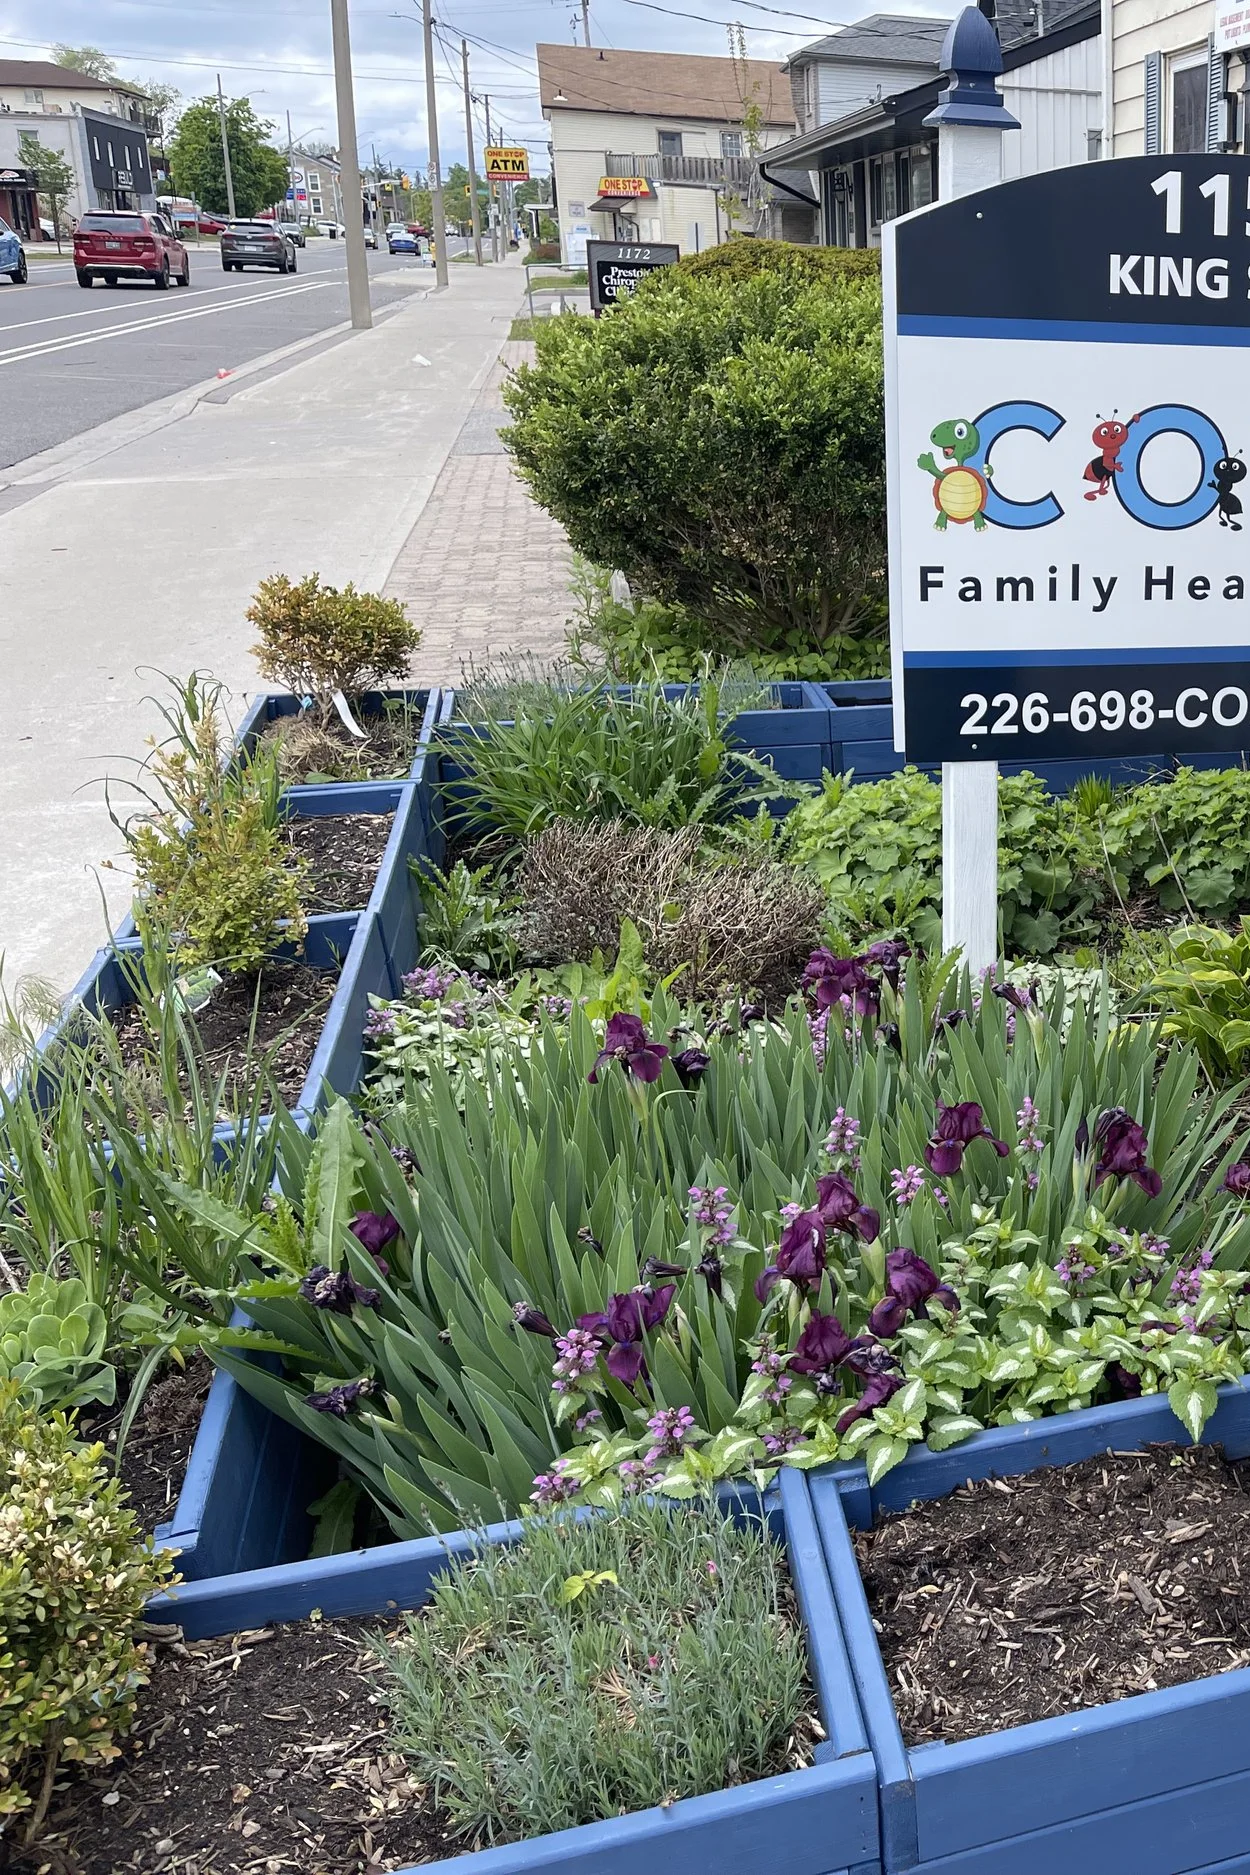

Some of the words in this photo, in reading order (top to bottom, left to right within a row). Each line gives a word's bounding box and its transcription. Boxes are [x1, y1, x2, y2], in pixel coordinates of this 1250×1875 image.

[487, 150, 503, 158] ONE
[504, 150, 525, 158] STOP
[490, 159, 525, 171] ATM
[604, 179, 621, 190] ONE
[622, 179, 643, 190] STOP
[617, 247, 651, 260] 1172
[1109, 253, 1229, 299] KING
[918, 562, 1119, 614] Family
